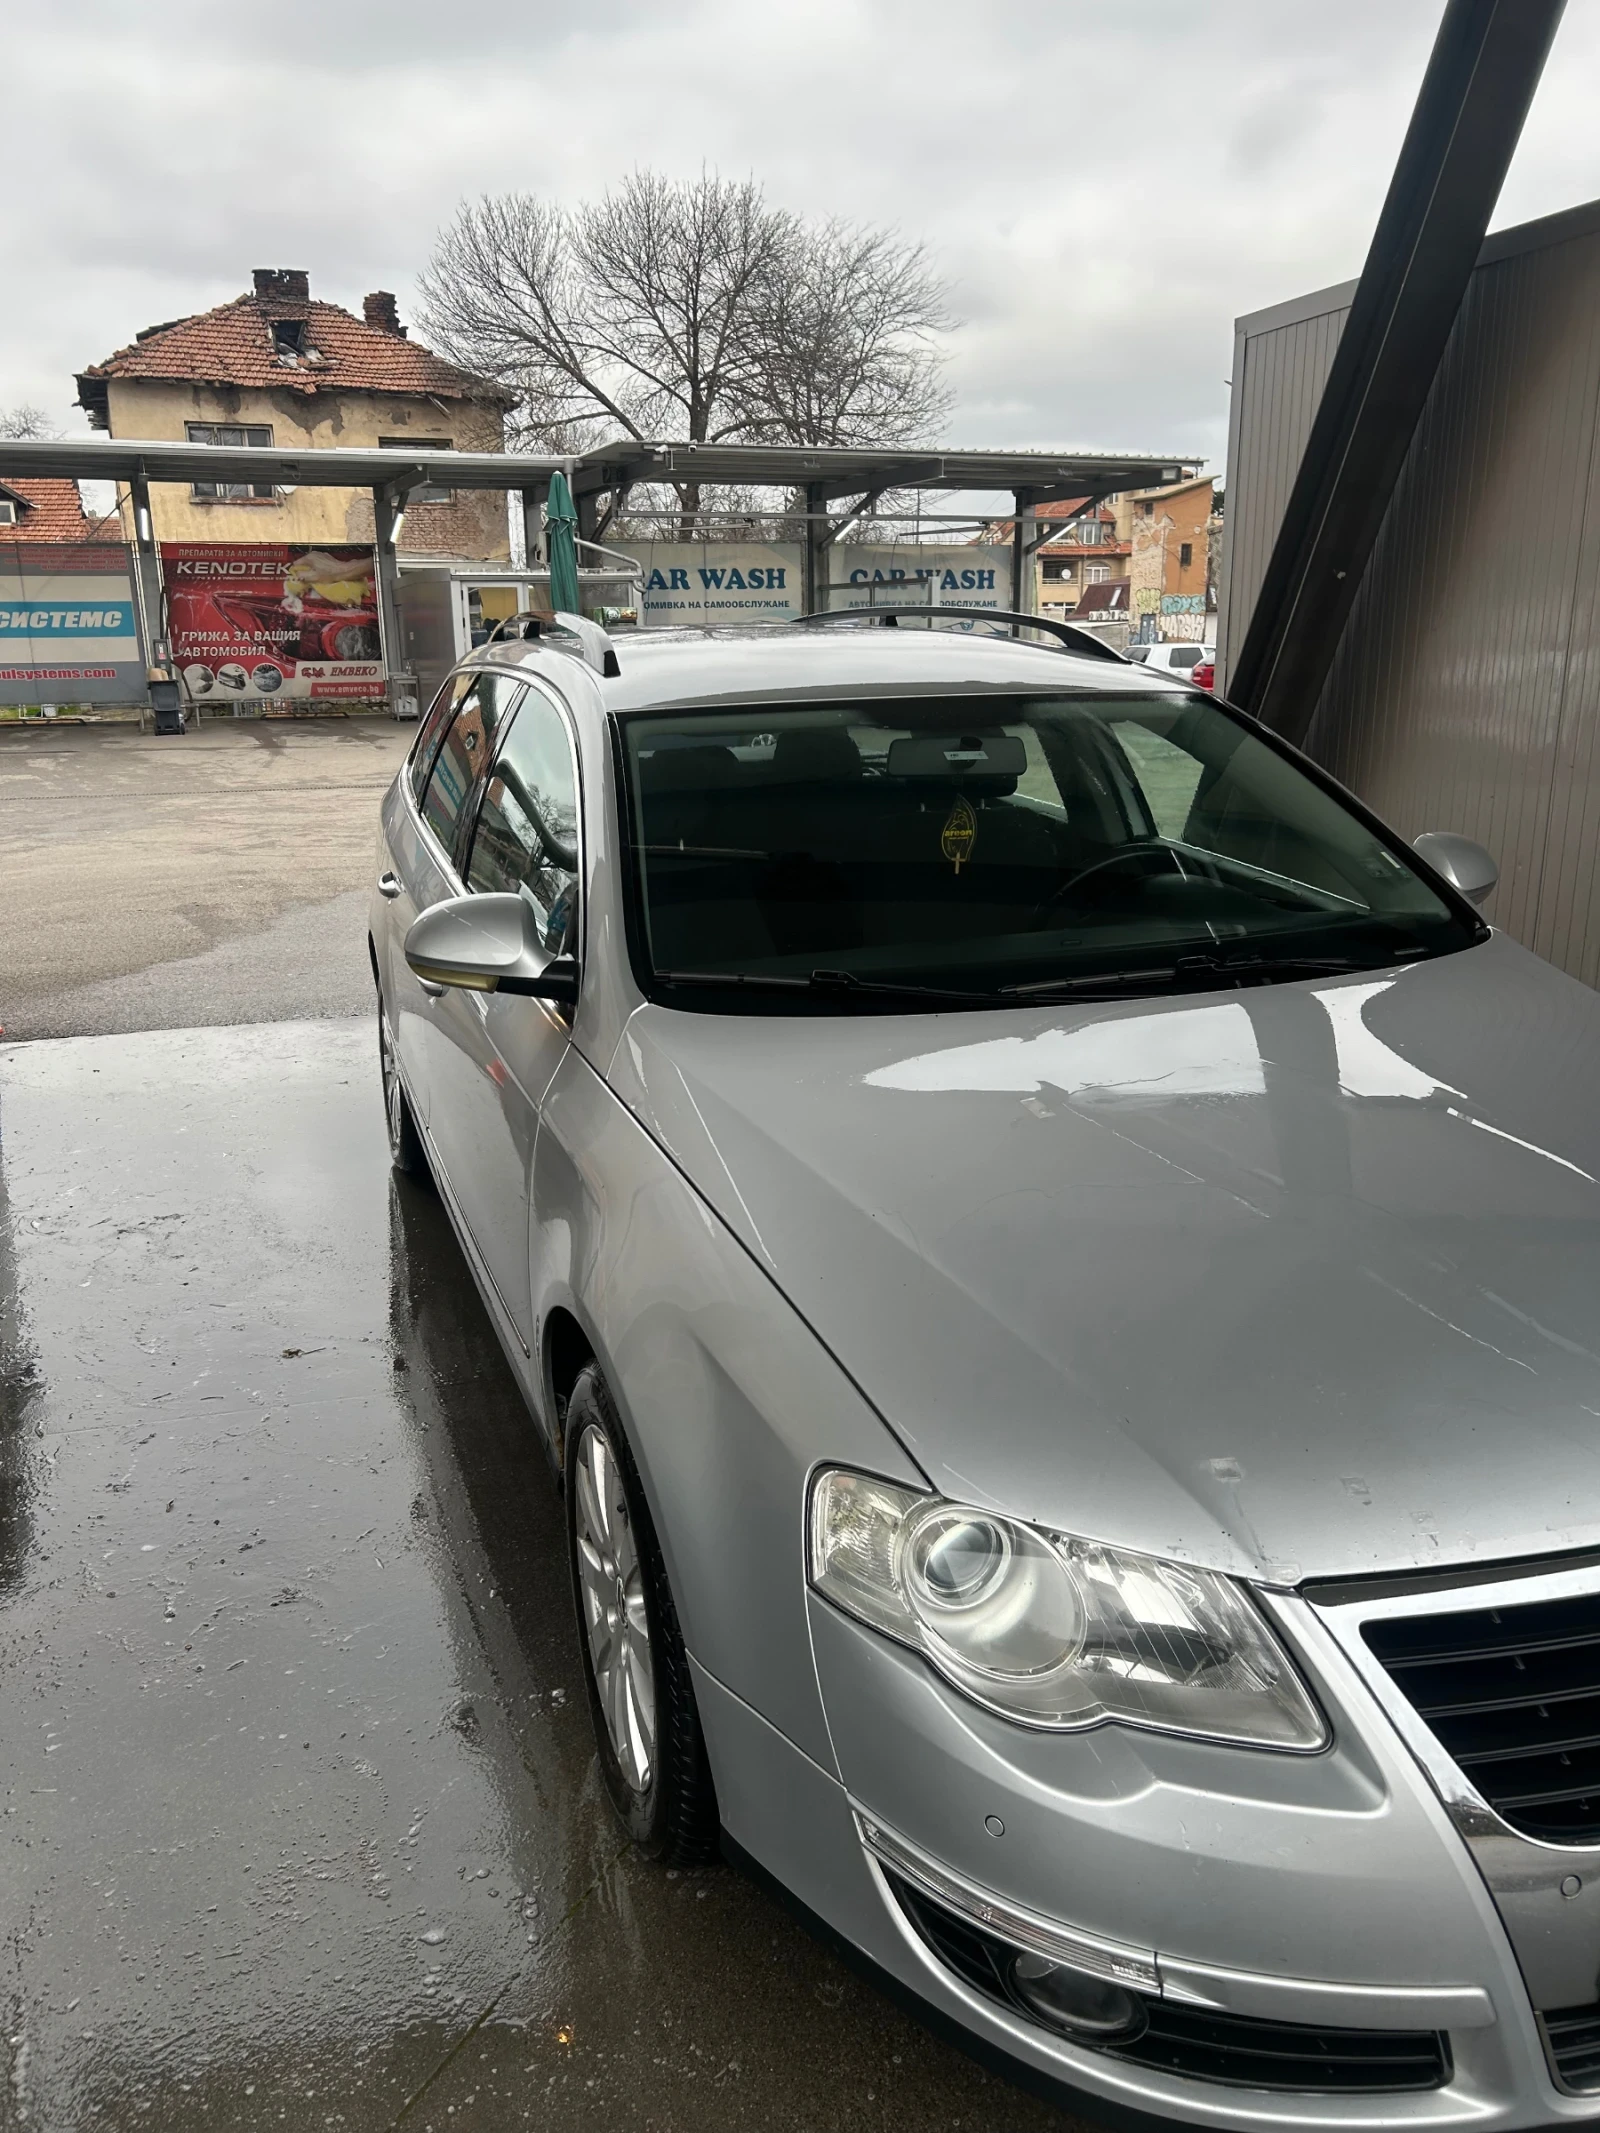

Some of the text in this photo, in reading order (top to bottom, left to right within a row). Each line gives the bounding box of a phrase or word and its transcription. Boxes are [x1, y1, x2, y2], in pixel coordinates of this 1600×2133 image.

[179, 549, 224, 557] ПРЕПАРАТИ
[226, 549, 235, 557] ЗА
[177, 561, 292, 575] KENOTEK
[646, 568, 786, 590] AR WASH
[850, 569, 908, 590] CAR
[688, 601, 700, 609] НА
[704, 600, 790, 608] САМООБСЛУЖАНЕ
[0, 611, 122, 628] СИСТЕМС
[181, 631, 301, 642] ГРИЖА ЗА ВАШИЯ
[183, 646, 267, 657] АВТОМОБИЛ
[316, 684, 379, 694] www.emveco.bg
